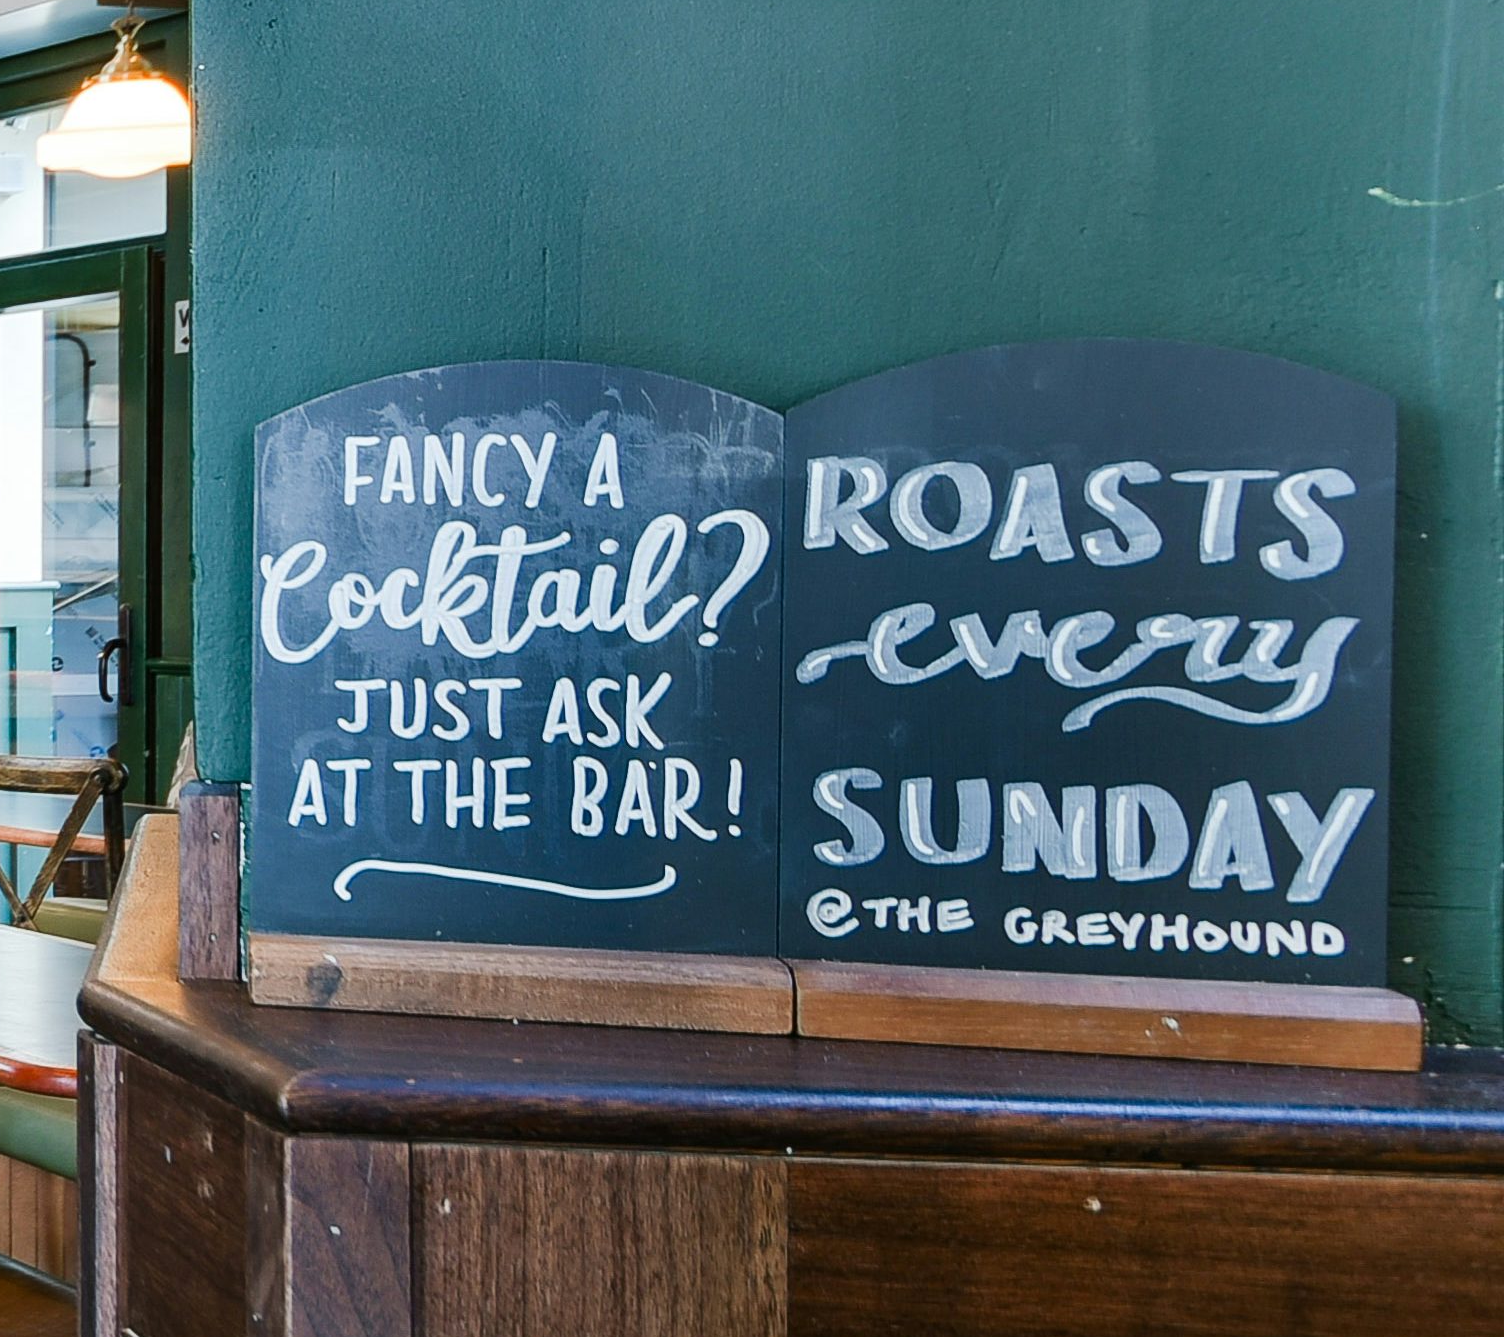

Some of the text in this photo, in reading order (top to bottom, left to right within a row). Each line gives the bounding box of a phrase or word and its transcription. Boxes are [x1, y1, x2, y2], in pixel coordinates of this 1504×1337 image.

[344, 431, 624, 509] FANCY A
[803, 456, 1357, 581] ROASTS
[260, 509, 770, 664] Cocktail?
[334, 672, 672, 751] JUST ASK
[796, 602, 1361, 732] every
[288, 756, 743, 841] AT THE BAR!
[813, 767, 1376, 903] SUNDAY
[1004, 907, 1346, 957] GREYHOUND
